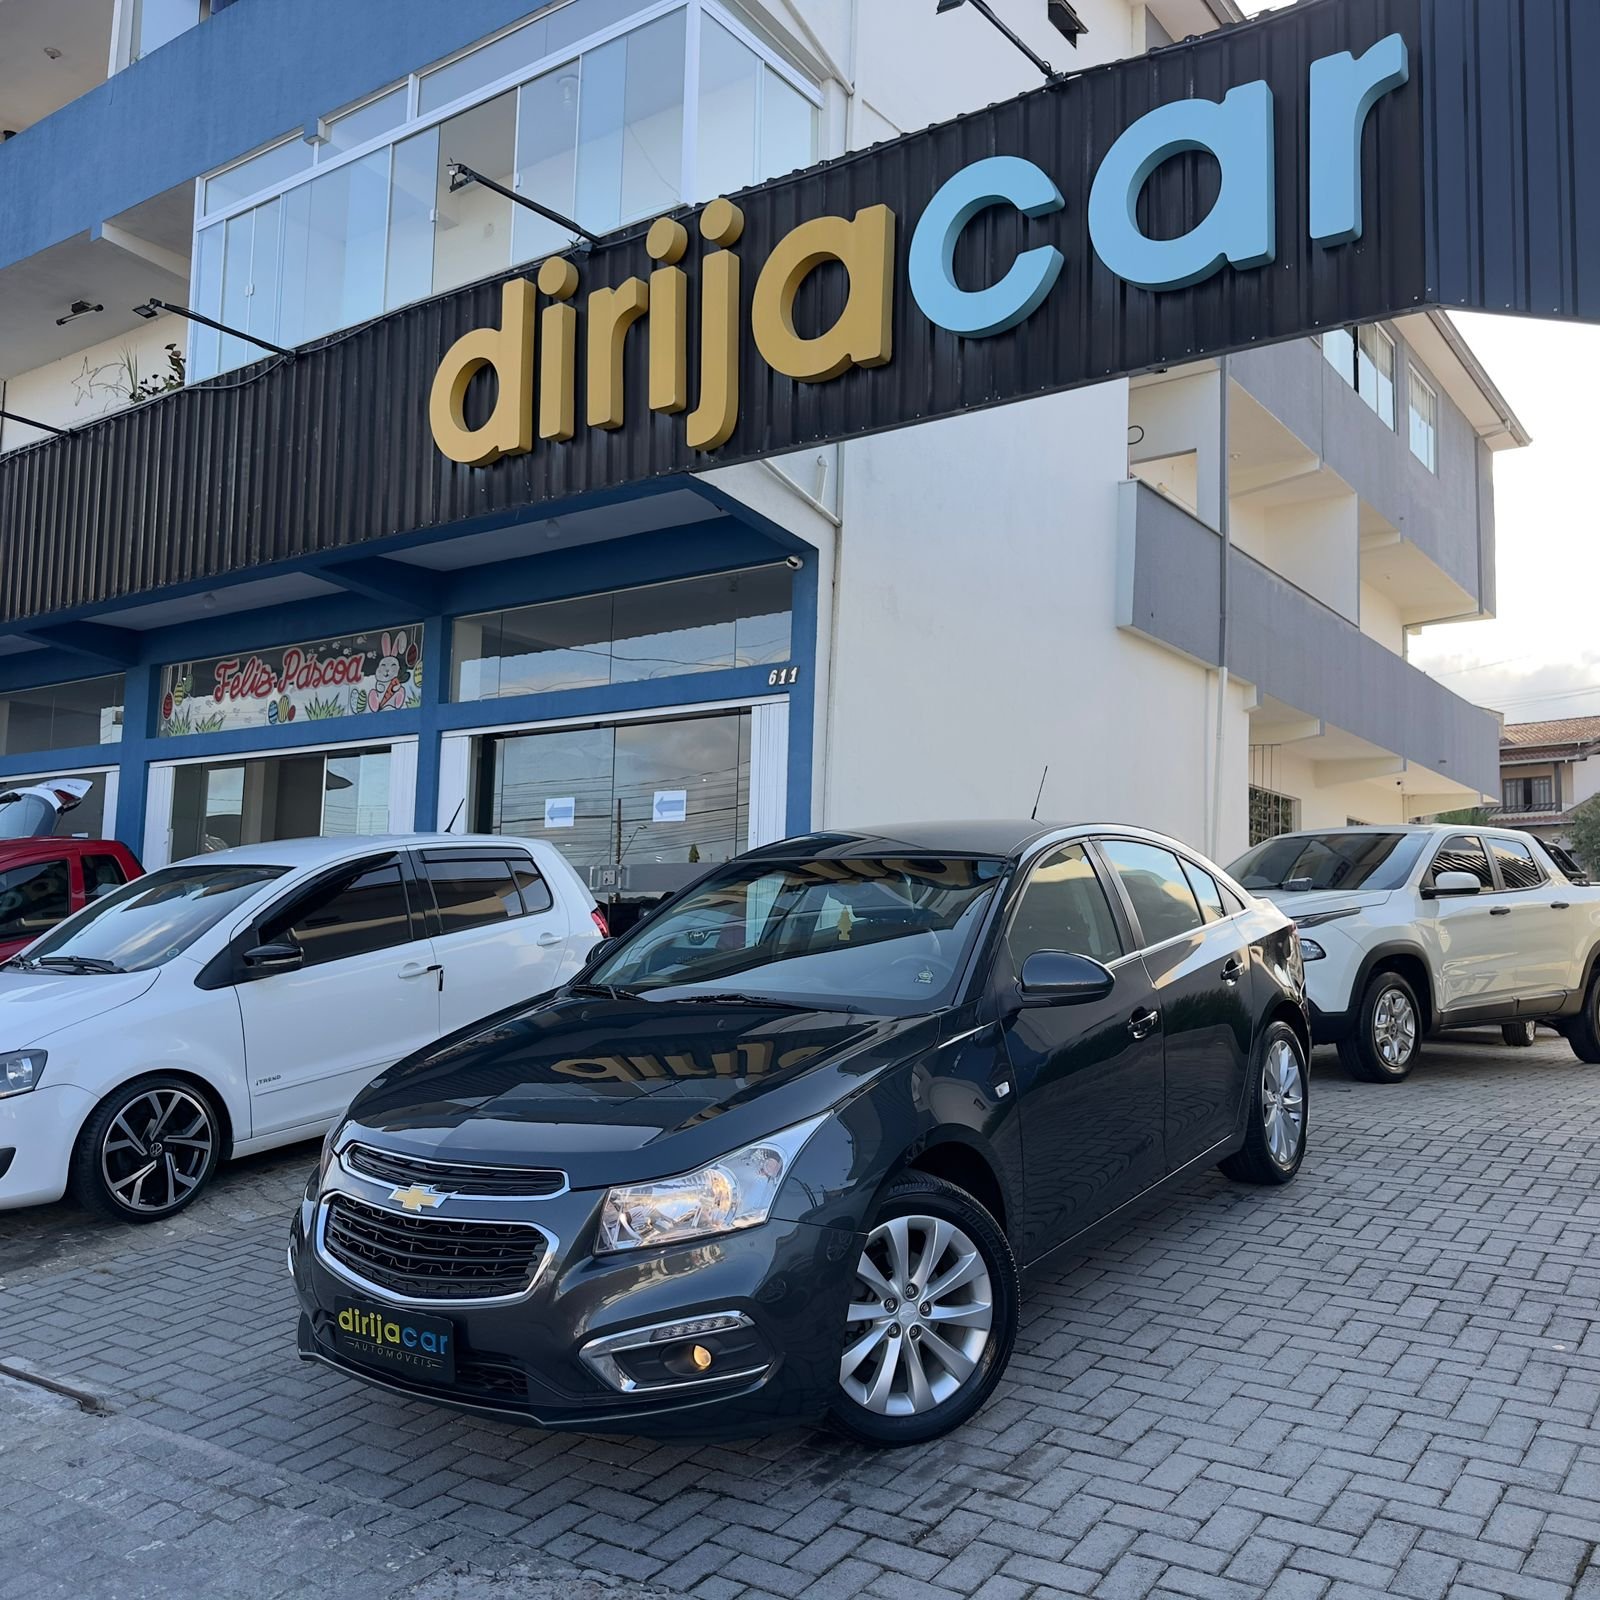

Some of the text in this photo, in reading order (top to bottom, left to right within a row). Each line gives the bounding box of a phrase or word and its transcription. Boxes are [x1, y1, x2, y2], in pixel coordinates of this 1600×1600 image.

[429, 32, 1409, 467] dirijacar
[214, 648, 364, 703] Feliz Páscoa
[768, 666, 798, 686] 611
[338, 1307, 448, 1354] dirijacar
[354, 1341, 432, 1368] AUTOMÓVEIS
